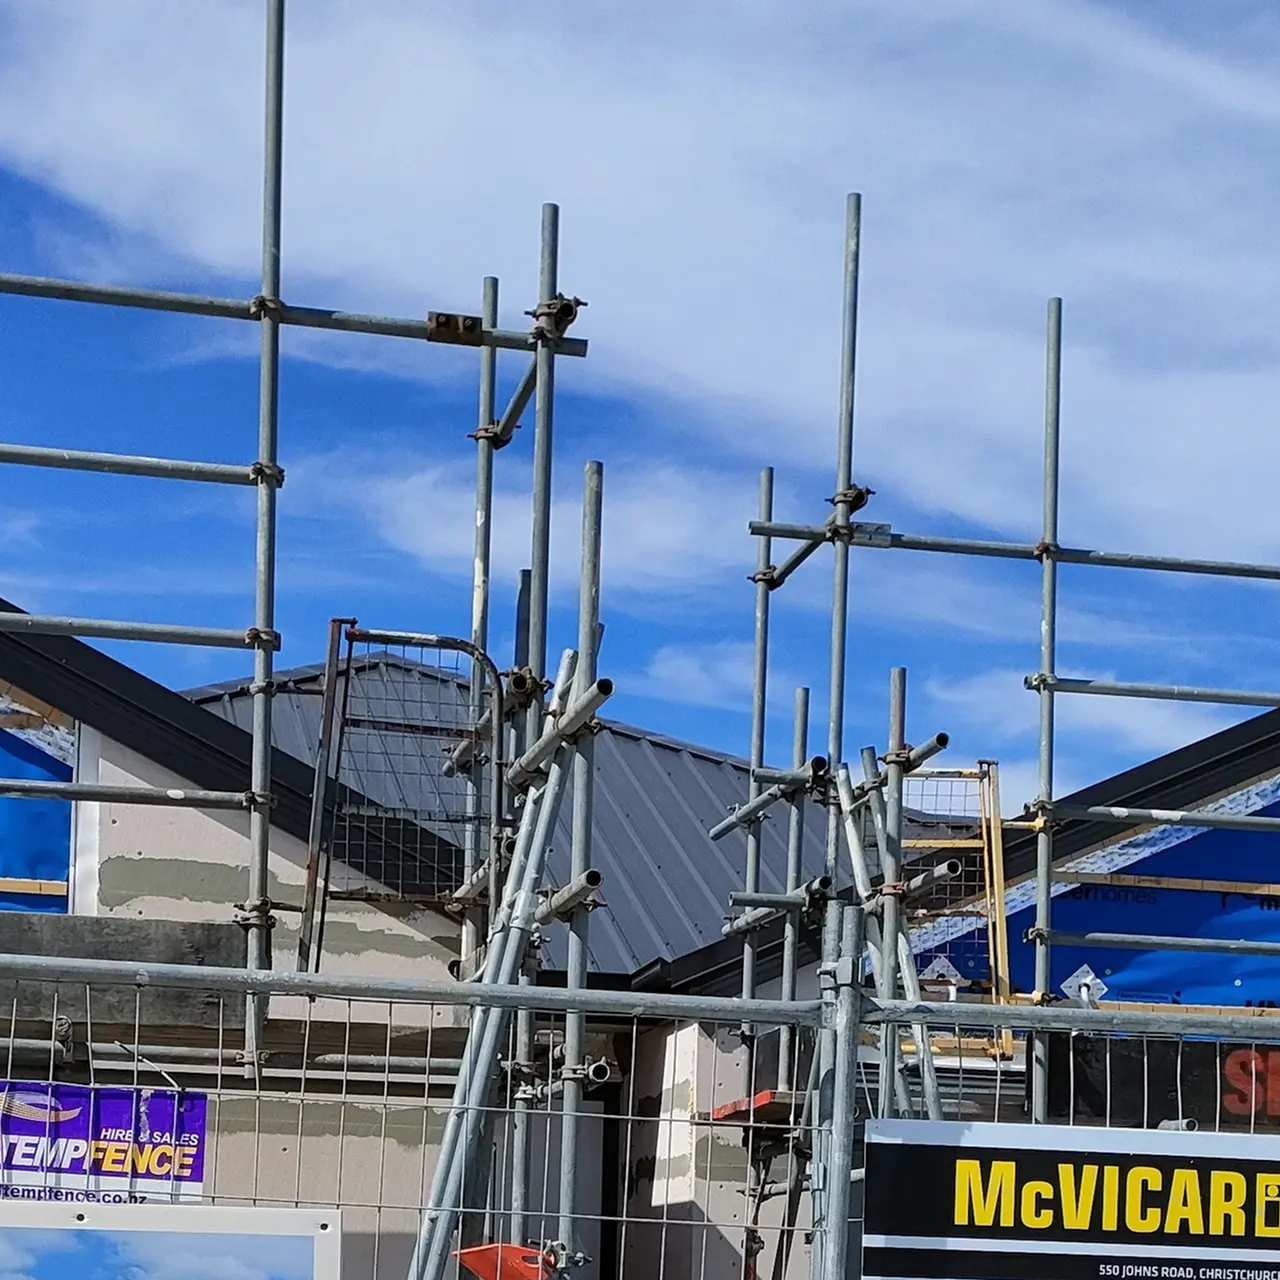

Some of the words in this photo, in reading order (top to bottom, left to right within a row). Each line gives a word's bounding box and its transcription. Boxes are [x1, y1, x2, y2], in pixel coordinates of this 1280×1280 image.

[100, 1128, 133, 1140] HIRE
[953, 1159, 1247, 1237] McVICAR
[1099, 1264, 1119, 1276] 550
[1121, 1265, 1158, 1278] JOHNS
[1161, 1267, 1197, 1280] ROAD,
